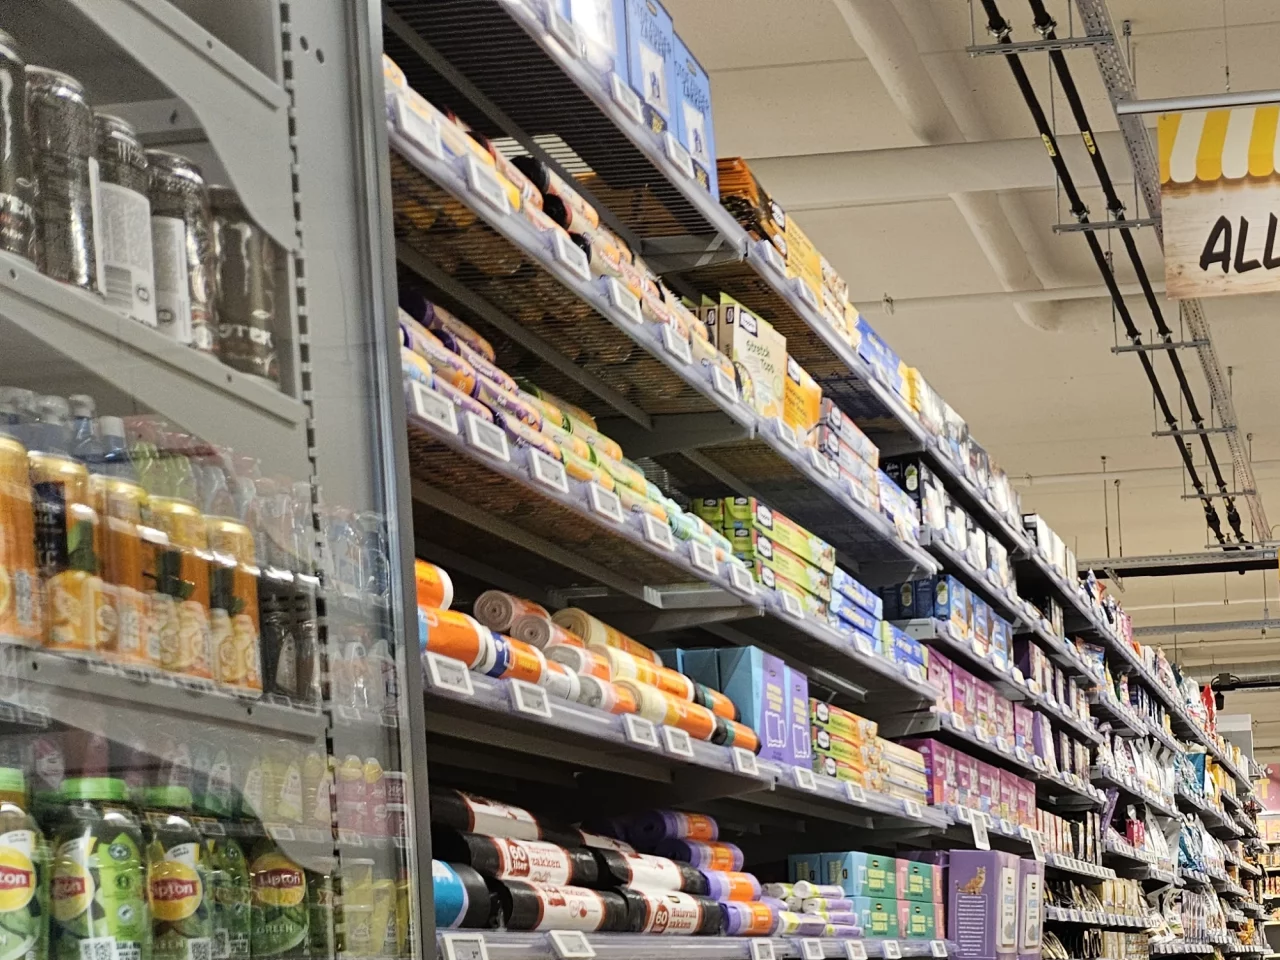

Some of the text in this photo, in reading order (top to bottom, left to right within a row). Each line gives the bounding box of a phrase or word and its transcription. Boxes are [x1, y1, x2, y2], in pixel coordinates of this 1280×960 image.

[509, 845, 526, 862] 60
[511, 861, 528, 872] liter
[530, 857, 562, 869] zakken
[258, 870, 301, 888] Lipton
[655, 912, 669, 926] 60
